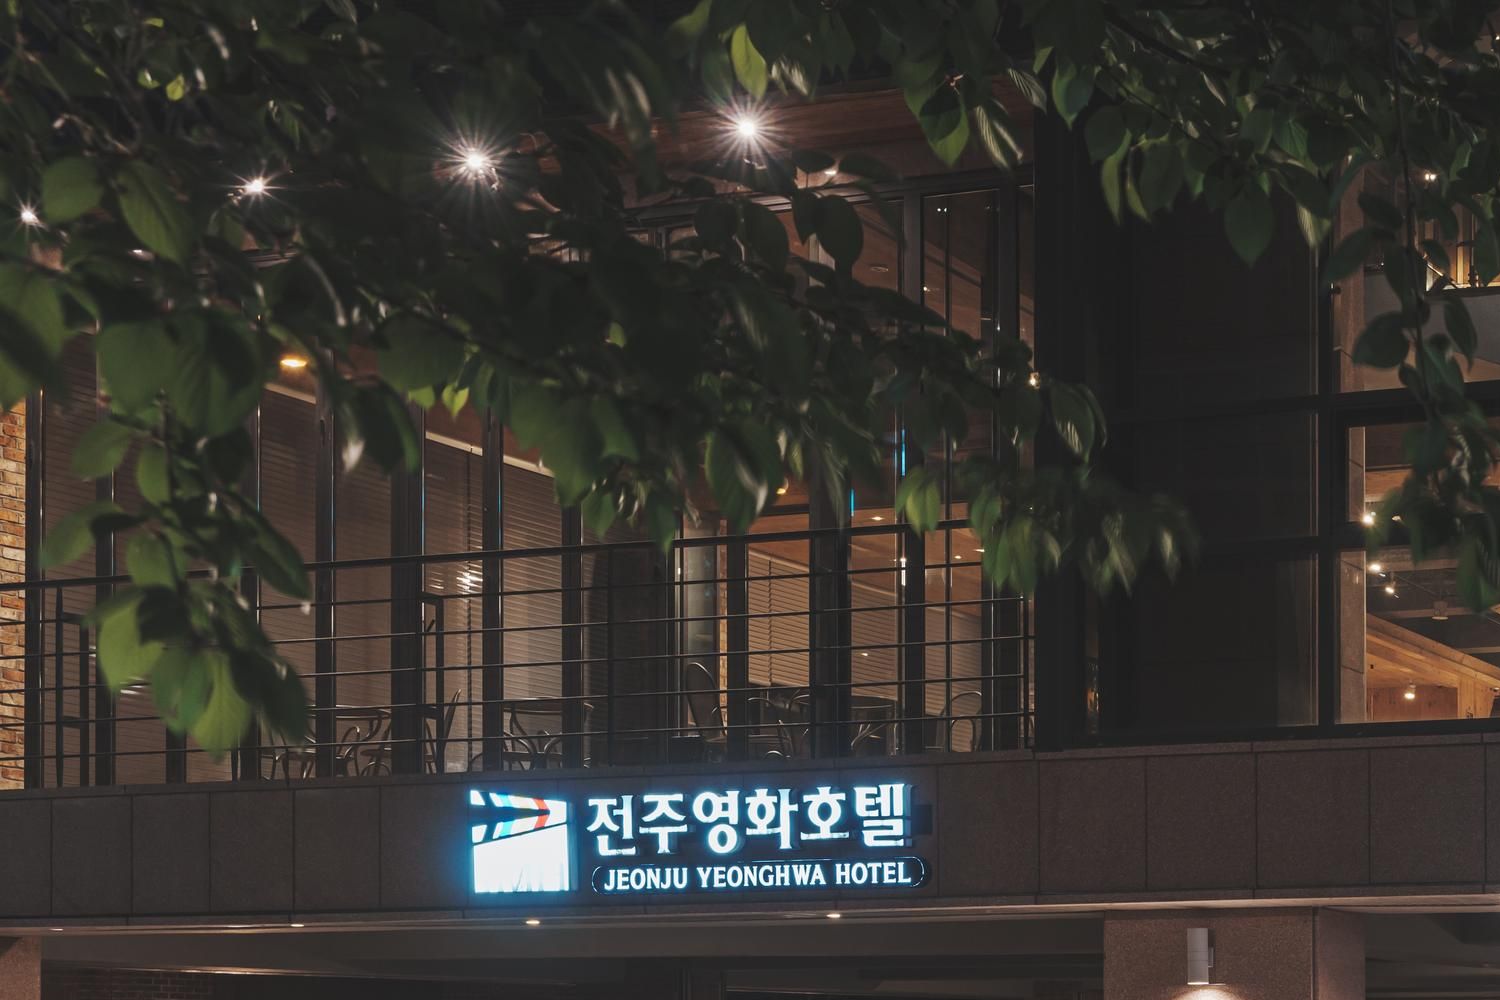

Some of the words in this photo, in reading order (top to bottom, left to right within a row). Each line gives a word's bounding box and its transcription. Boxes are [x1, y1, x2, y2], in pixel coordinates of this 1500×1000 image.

[586, 783, 905, 856] 전주영화호텔
[603, 867, 688, 892] JEONJU
[697, 864, 827, 889] YEONGHWA
[834, 861, 912, 885] HOTEL
